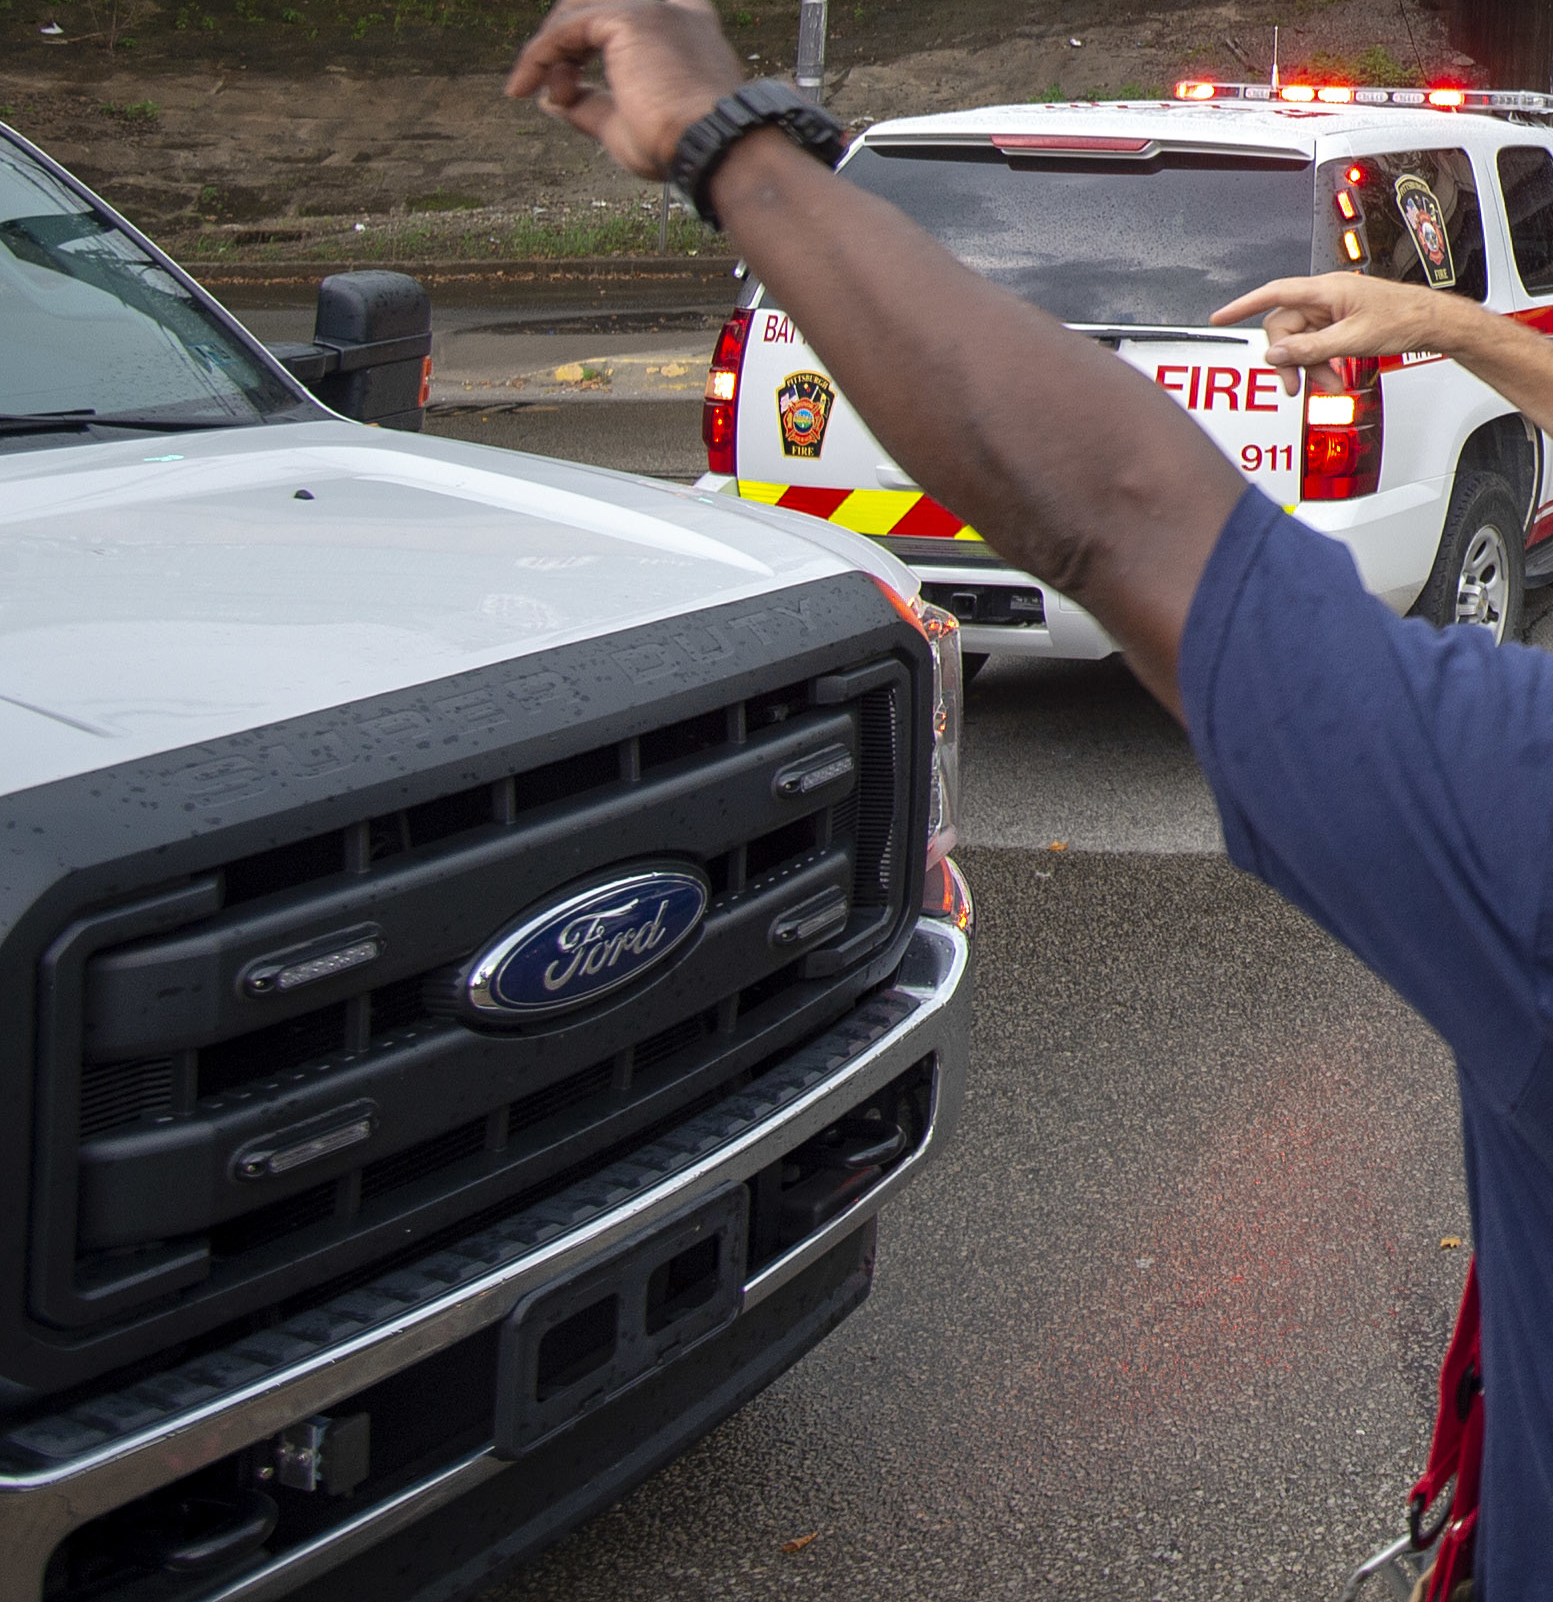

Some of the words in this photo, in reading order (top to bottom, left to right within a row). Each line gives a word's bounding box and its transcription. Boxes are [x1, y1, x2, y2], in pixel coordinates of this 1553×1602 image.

[786, 374, 828, 389] PITTSBURGH
[1155, 365, 1280, 412] FIRE
[791, 446, 815, 457] FIRE
[1241, 444, 1293, 472] 911
[178, 666, 585, 807] SUPER
[606, 597, 818, 686] DUTY
[543, 898, 670, 991] Ford
